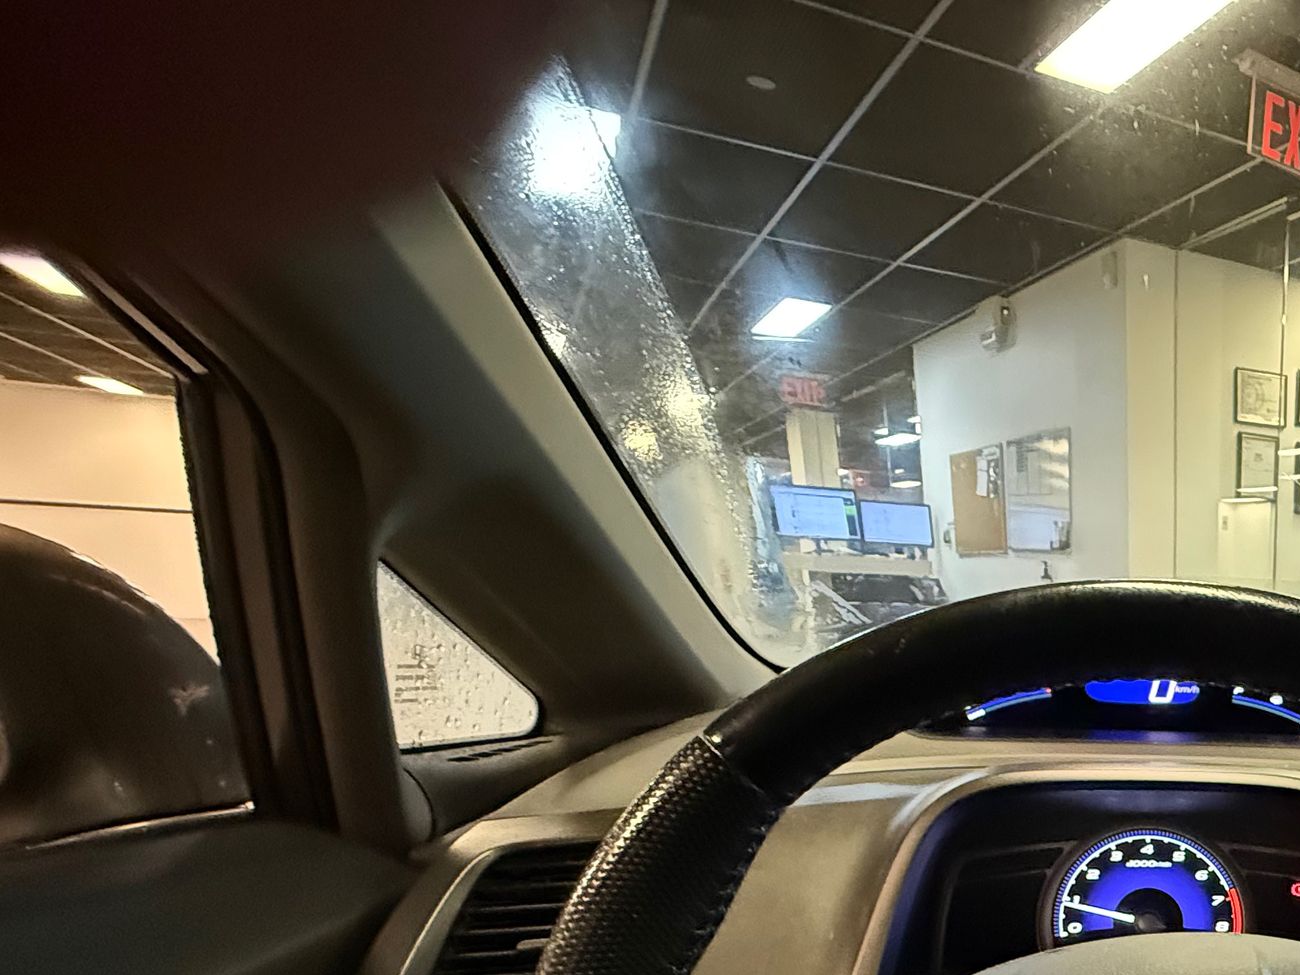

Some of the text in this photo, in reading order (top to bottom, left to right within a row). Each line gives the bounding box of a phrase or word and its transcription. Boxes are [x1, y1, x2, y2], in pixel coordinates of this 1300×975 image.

[1140, 844, 1154, 855] 4
[1085, 868, 1101, 880] 2
[1194, 869, 1209, 881] 6
[1211, 895, 1225, 907] 7
[1067, 922, 1083, 934] 0
[1215, 921, 1229, 932] 8
